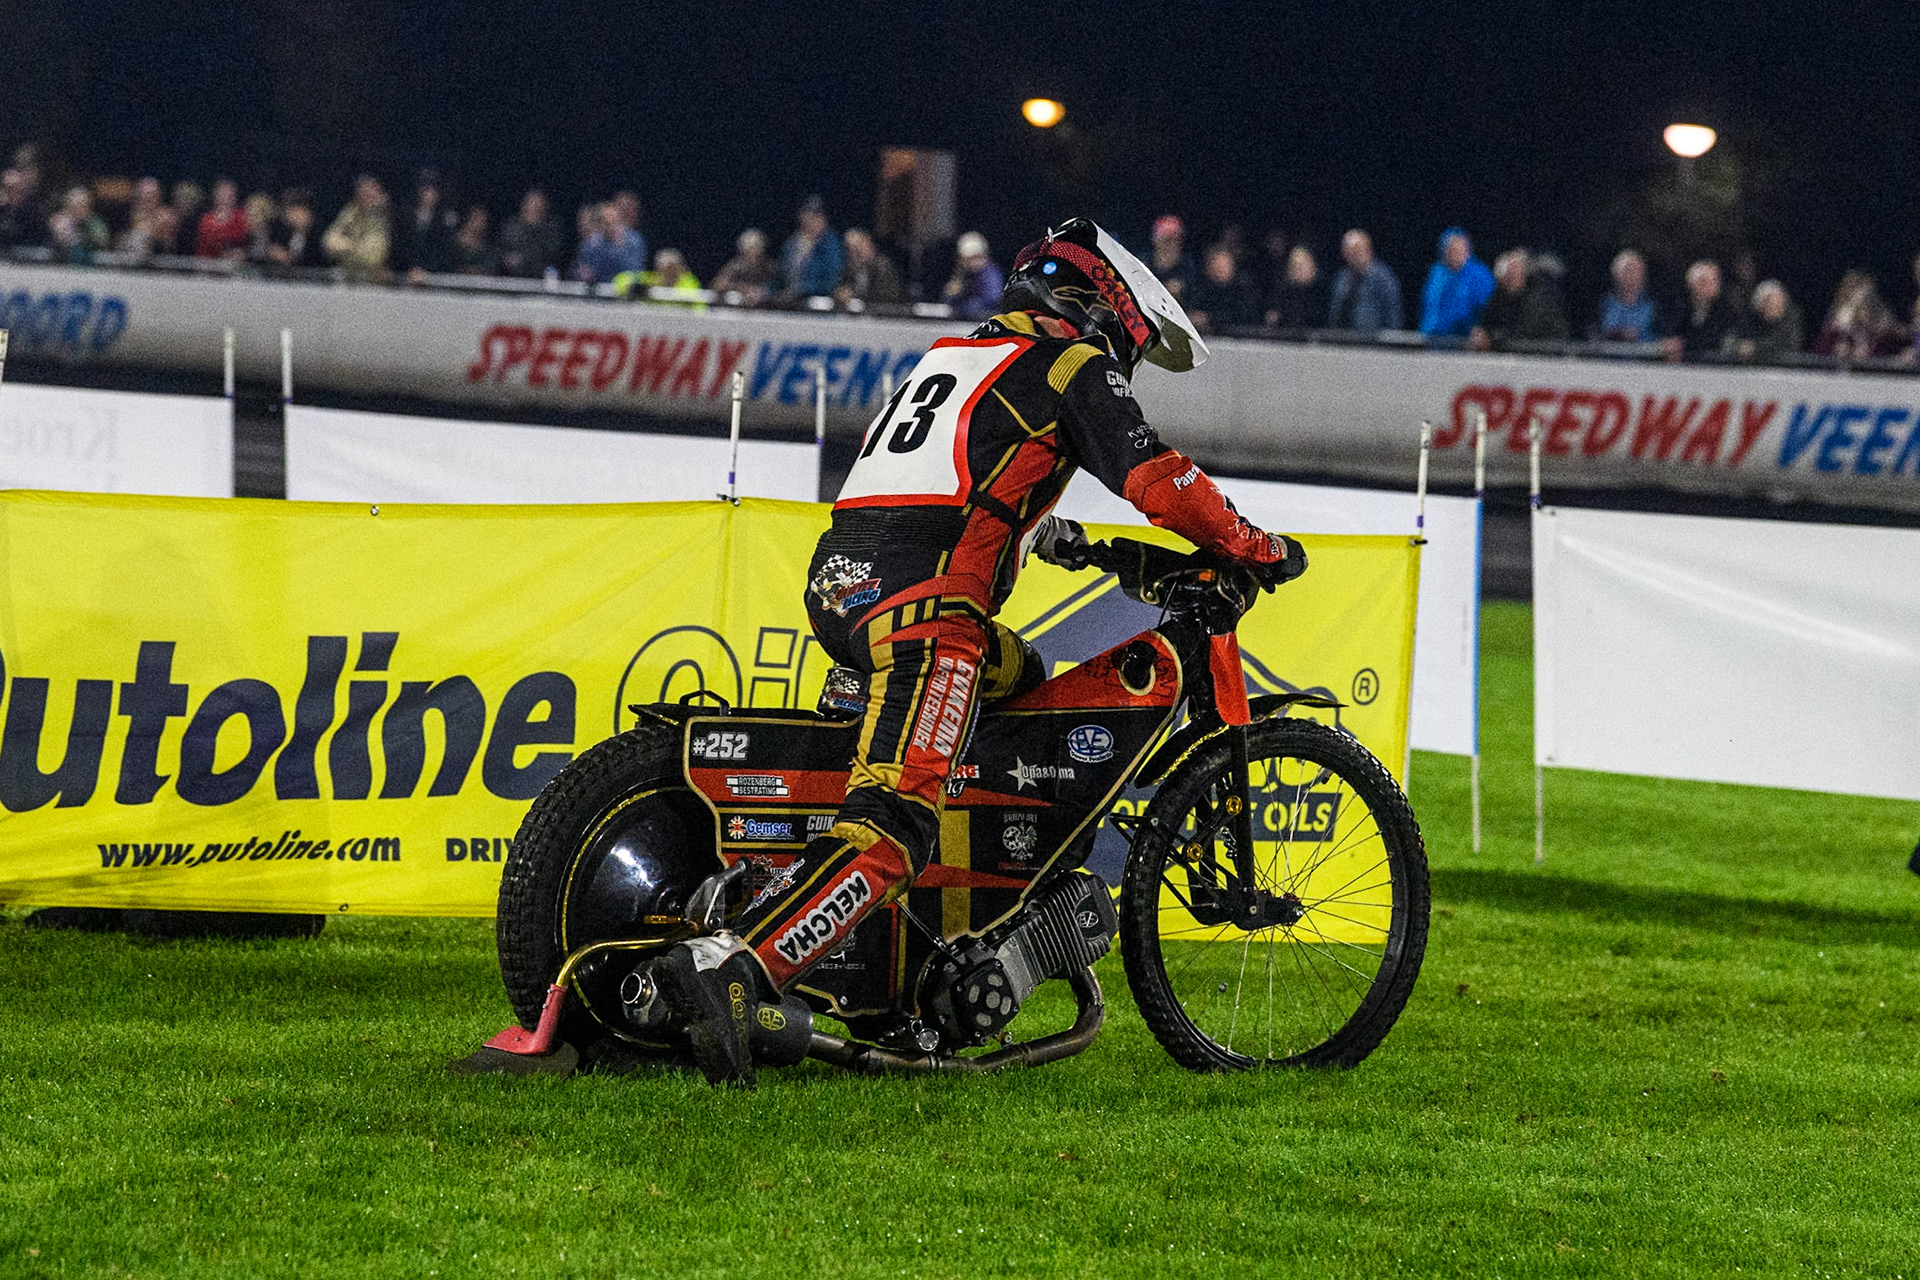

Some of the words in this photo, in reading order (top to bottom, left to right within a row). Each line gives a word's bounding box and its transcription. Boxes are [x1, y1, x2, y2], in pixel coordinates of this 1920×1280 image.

[0, 287, 128, 348] OORD
[468, 324, 748, 399] SPEEDWAY
[860, 373, 957, 460] 13
[1431, 385, 1779, 467] SPEEDWAY
[0, 631, 577, 813] utoline
[692, 732, 750, 760] #252
[738, 777, 777, 787] ROZENBERG
[738, 786, 777, 796] BESTRATING
[746, 819, 792, 835] Gemser
[1263, 802, 1333, 832] OILS
[97, 829, 401, 868] www.putoline.com
[776, 871, 869, 965] KELCHA
